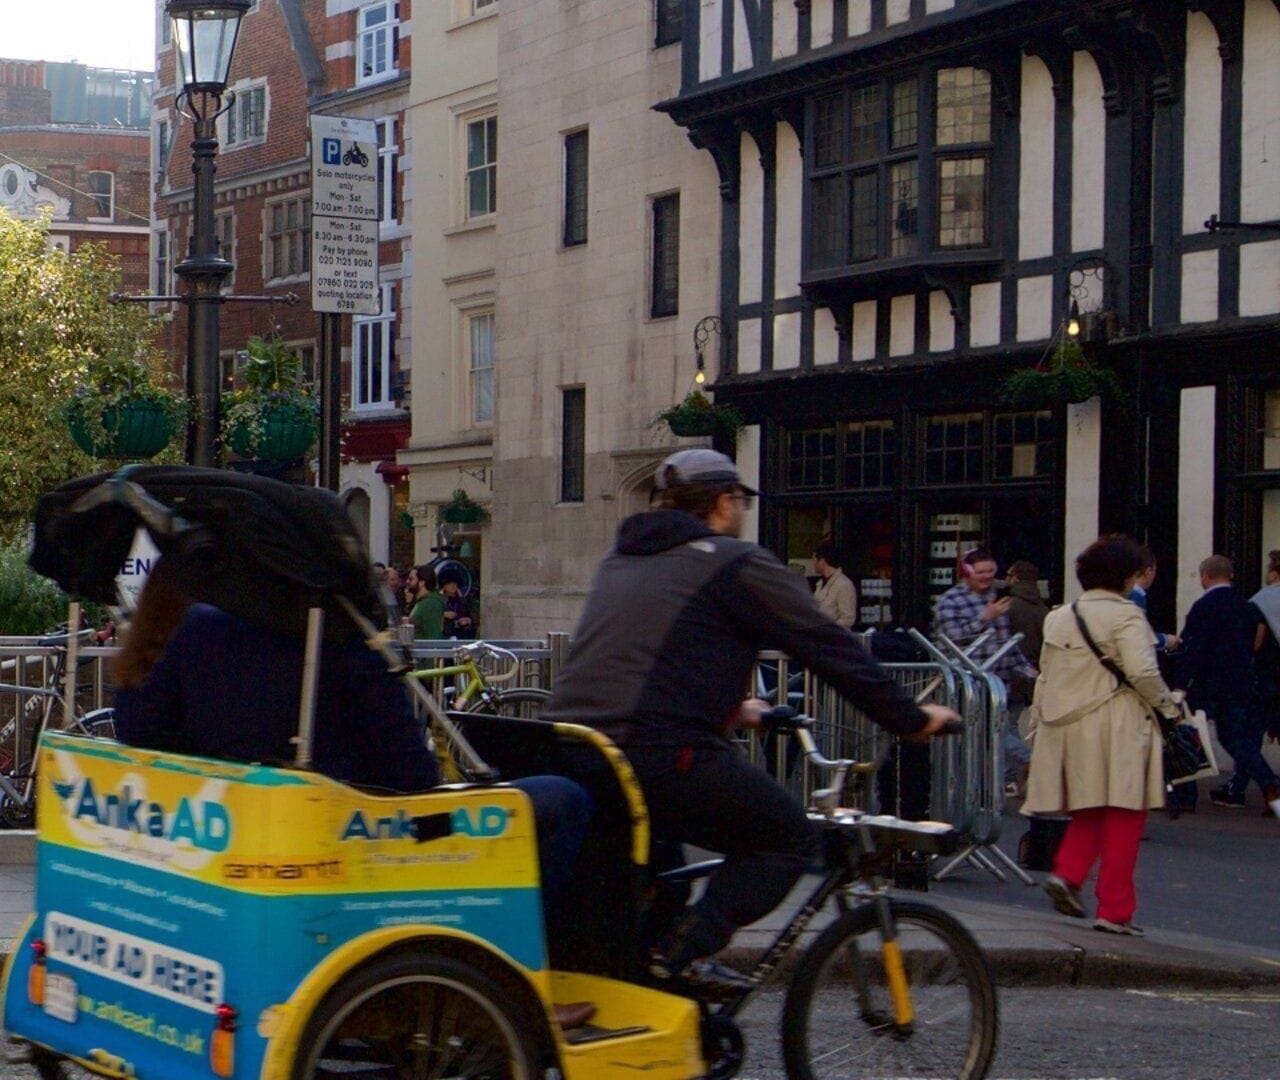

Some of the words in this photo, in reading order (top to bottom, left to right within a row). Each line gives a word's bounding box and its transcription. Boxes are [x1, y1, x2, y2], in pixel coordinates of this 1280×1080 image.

[316, 168, 333, 178] Solo
[334, 170, 376, 182] motorcycles
[338, 182, 353, 191] only
[329, 192, 345, 201] Mon
[350, 194, 362, 202] Sat
[329, 221, 345, 230] Mon
[350, 223, 362, 231] Sat
[323, 245, 336, 254] Pay
[337, 247, 346, 255] by
[347, 248, 368, 256] phone
[343, 270, 358, 278] text
[318, 289, 344, 299] quoting
[345, 291, 374, 300] location
[74, 777, 232, 853] AnkaAD
[341, 805, 509, 841] AnkAD
[53, 922, 111, 969] YOUR
[114, 943, 148, 979] AD
[151, 954, 217, 1005] HERE
